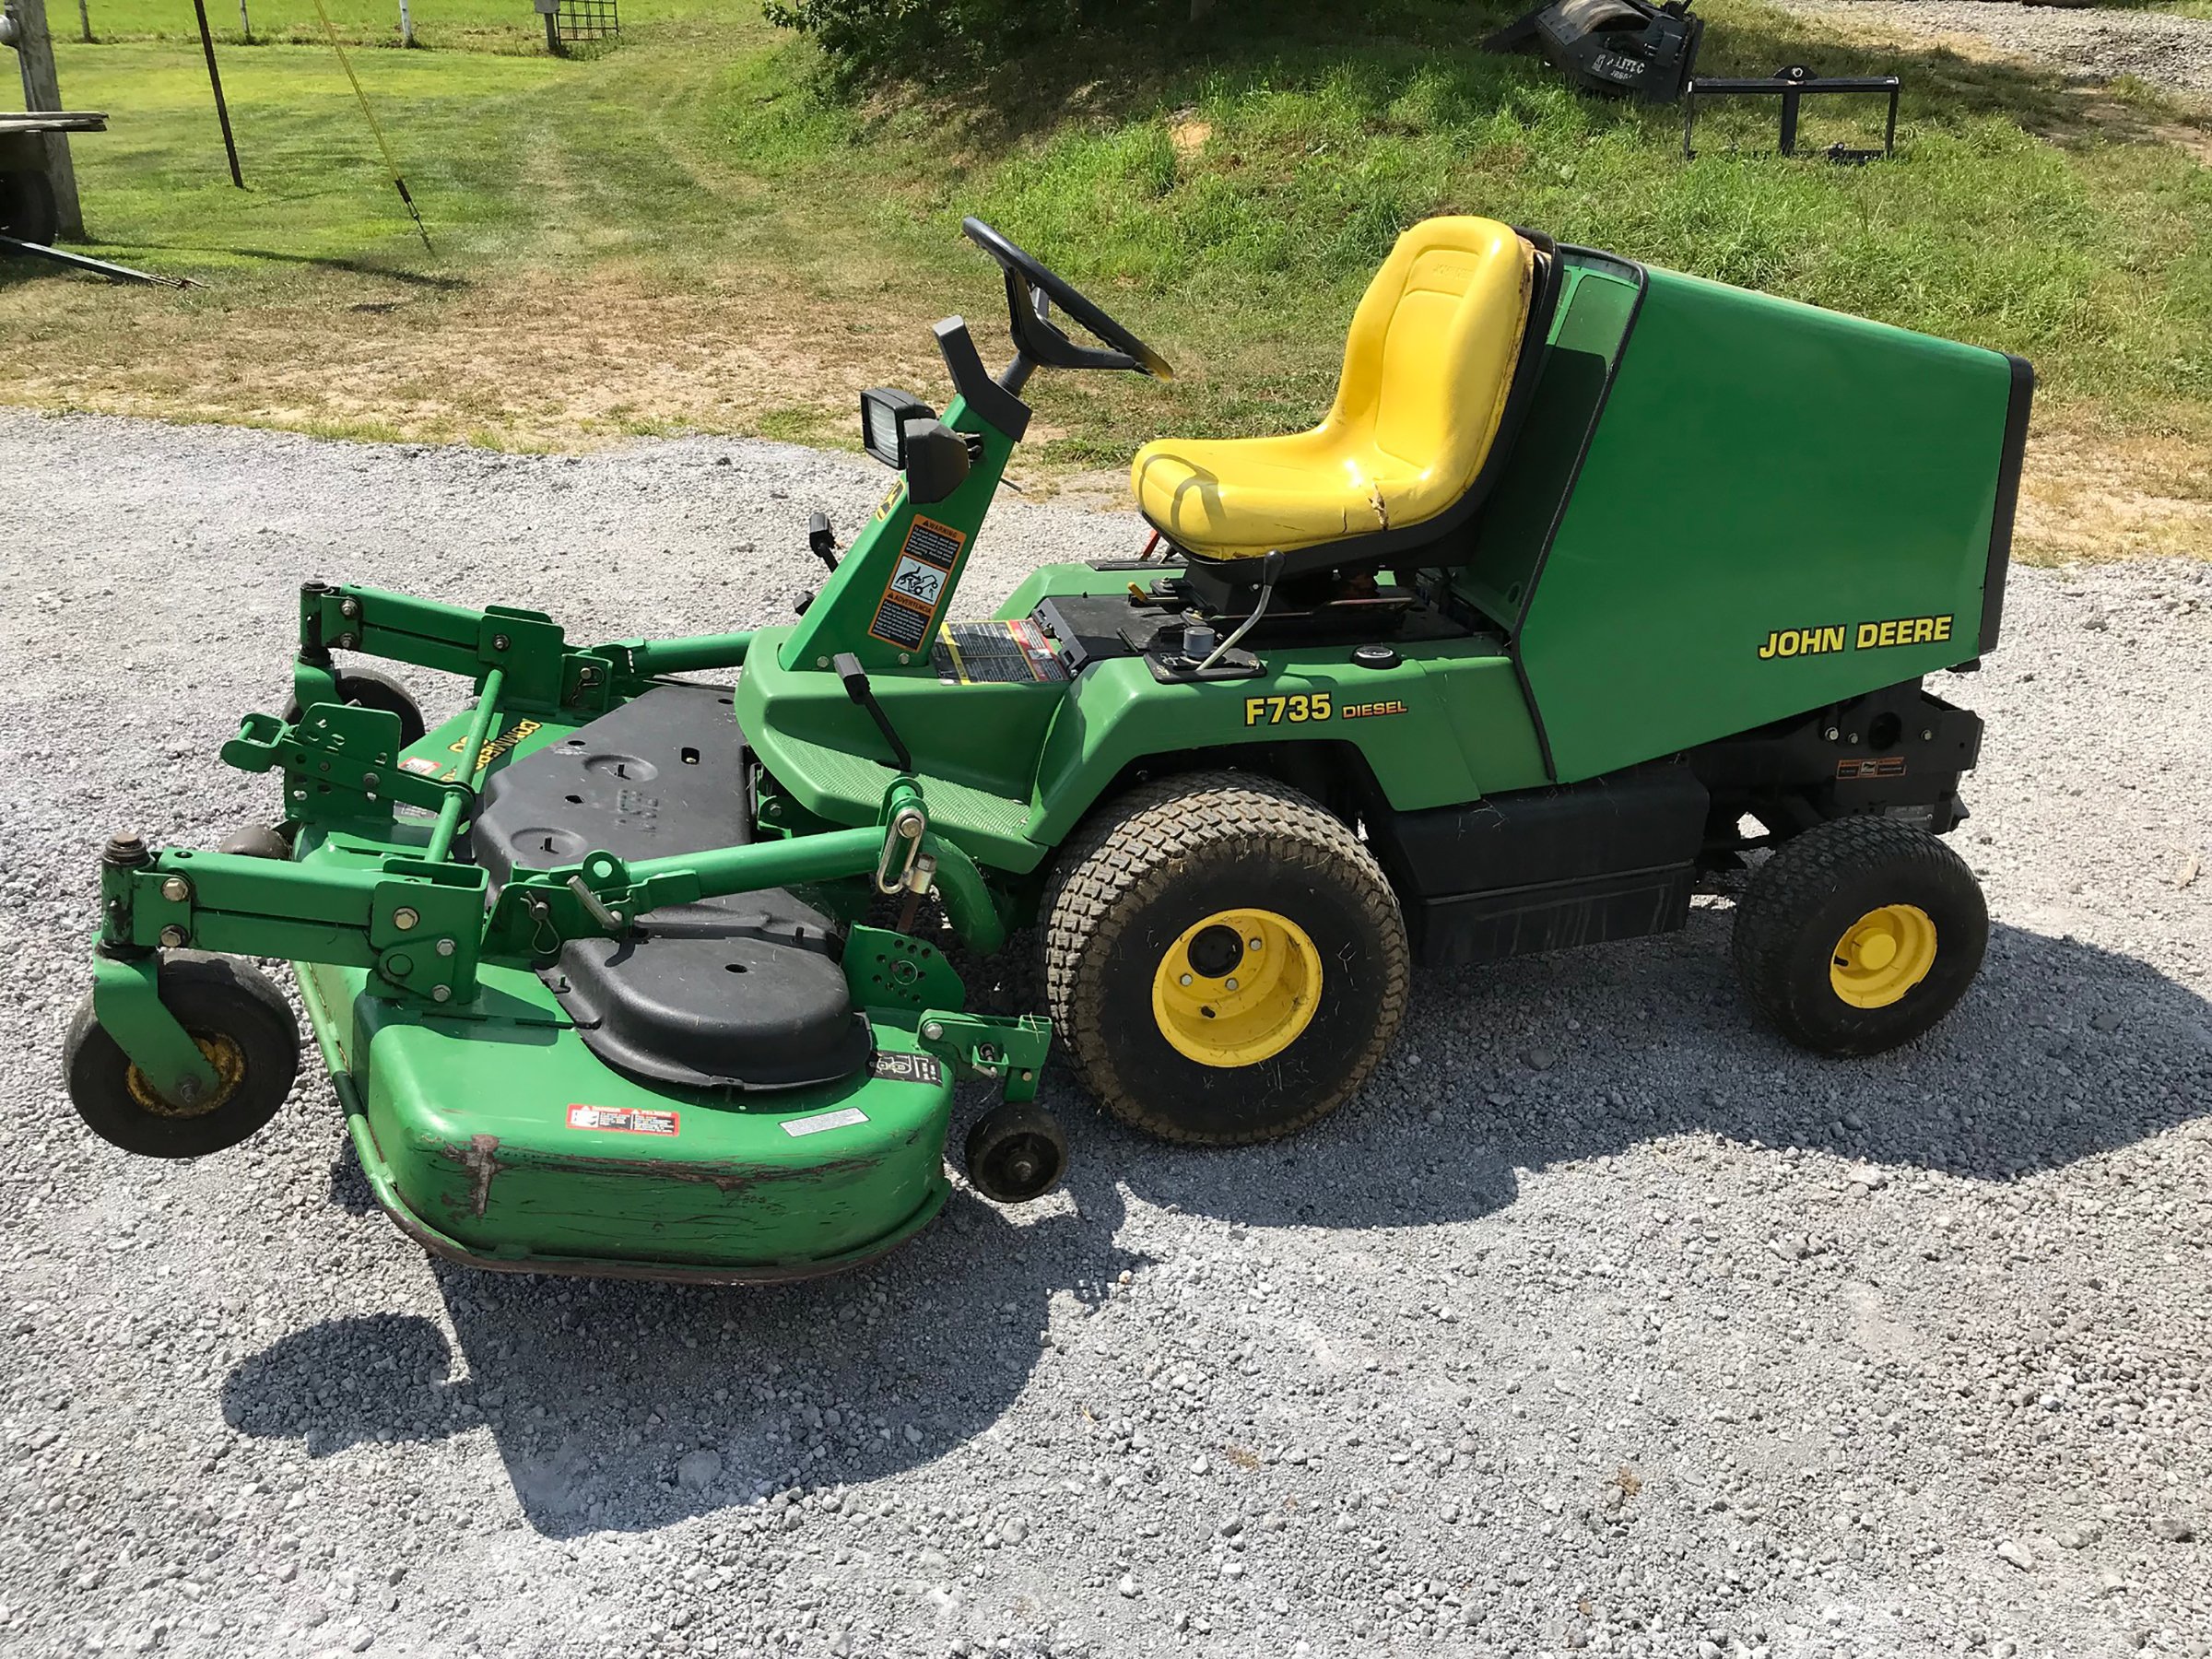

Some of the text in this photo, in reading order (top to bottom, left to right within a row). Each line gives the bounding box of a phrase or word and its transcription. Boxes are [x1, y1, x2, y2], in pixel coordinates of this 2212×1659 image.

[928, 523, 959, 539] WARNING
[1759, 614, 1954, 660] JOHN DEERE
[1244, 691, 1407, 726] F735 DIESEL
